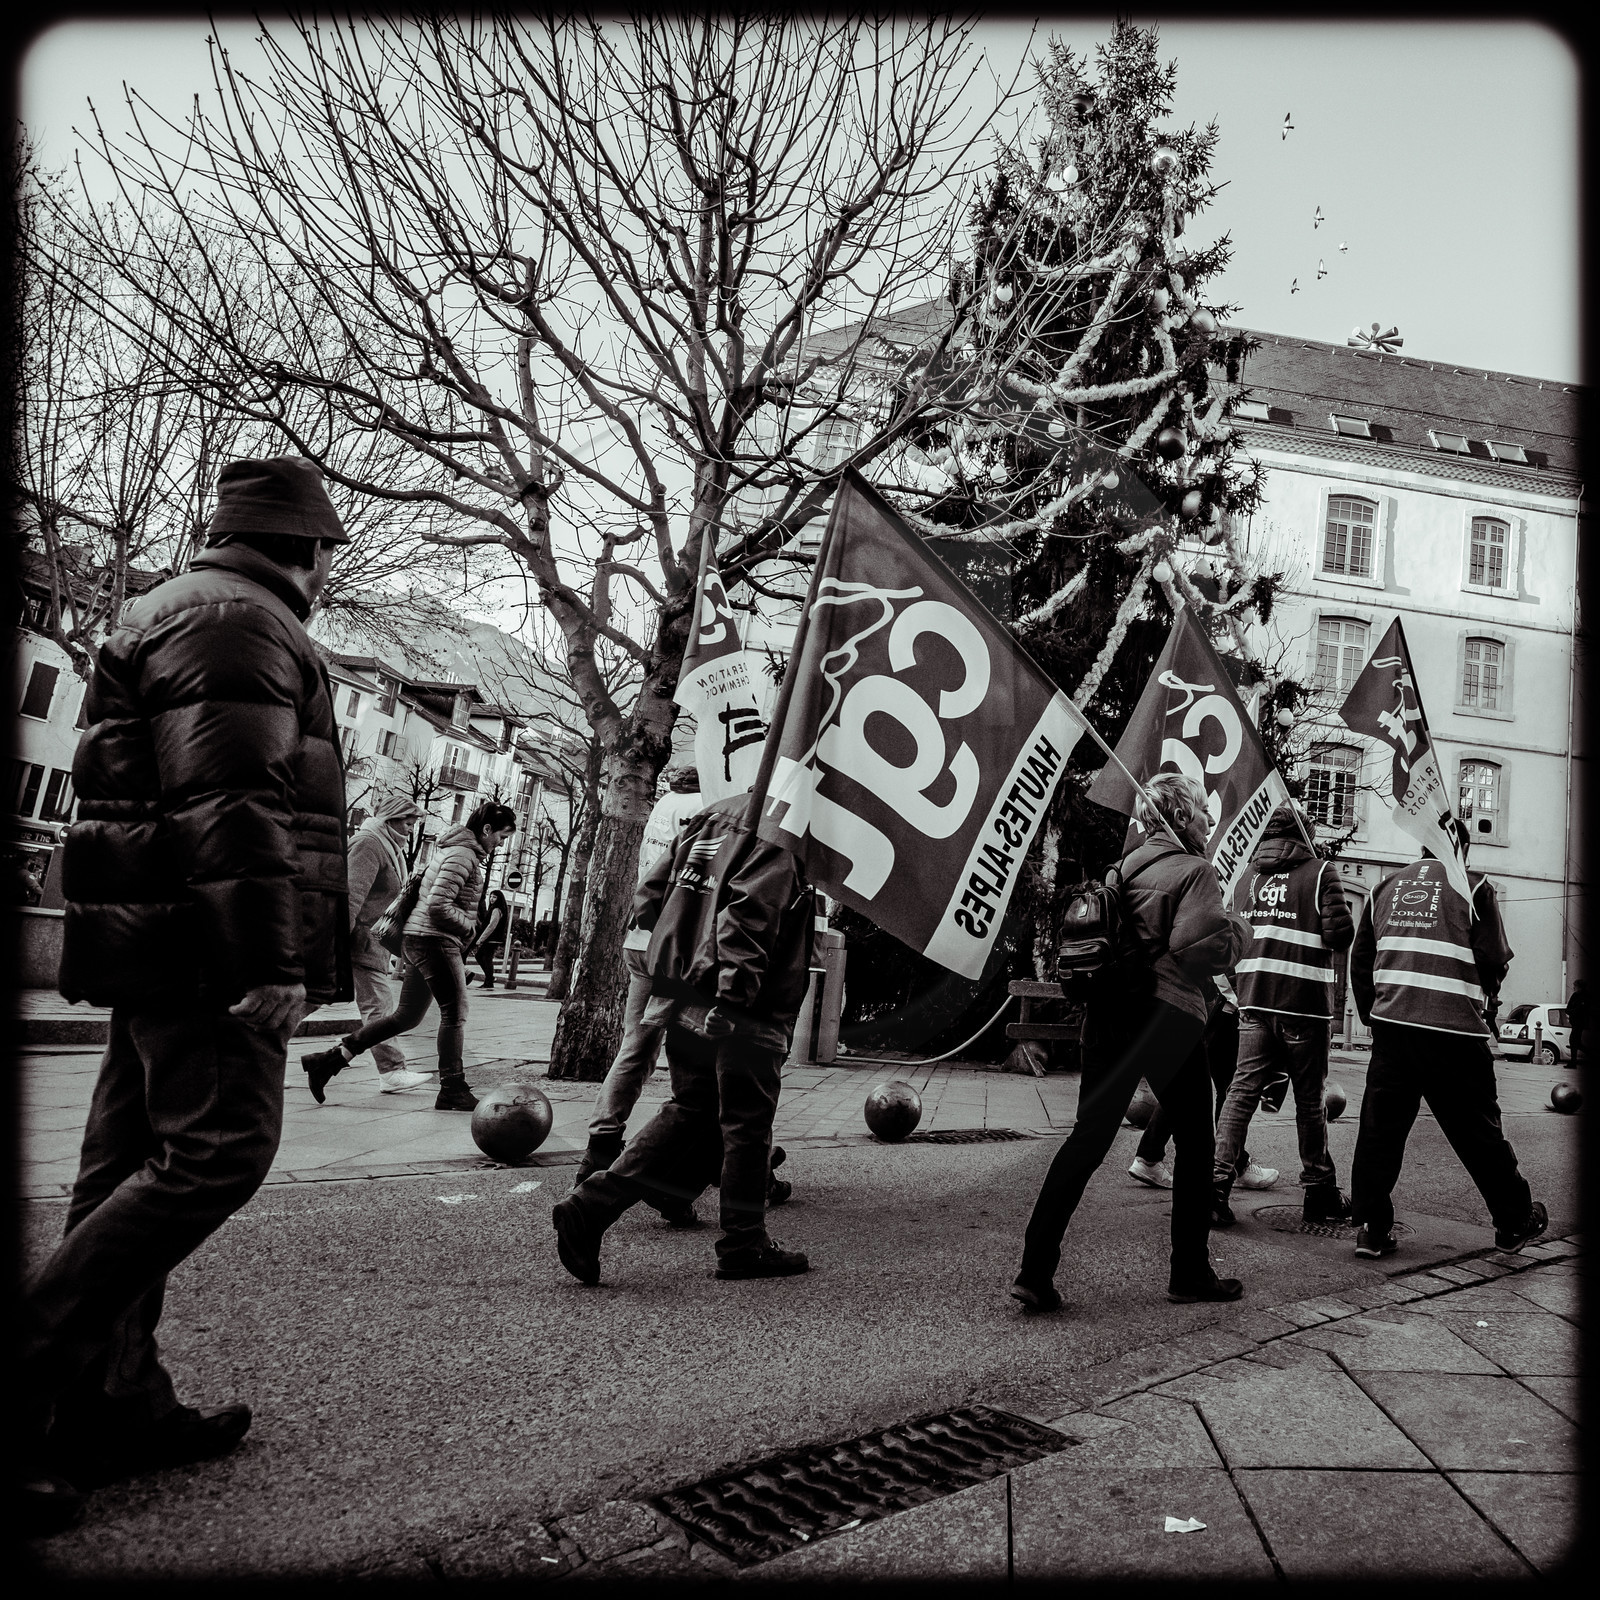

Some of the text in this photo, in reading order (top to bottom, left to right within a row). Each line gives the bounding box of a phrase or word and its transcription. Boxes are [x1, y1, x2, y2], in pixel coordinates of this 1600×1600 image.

[1258, 884, 1288, 906] cgt
[1430, 888, 1442, 911] TER
[1390, 910, 1438, 918] CORAIL
